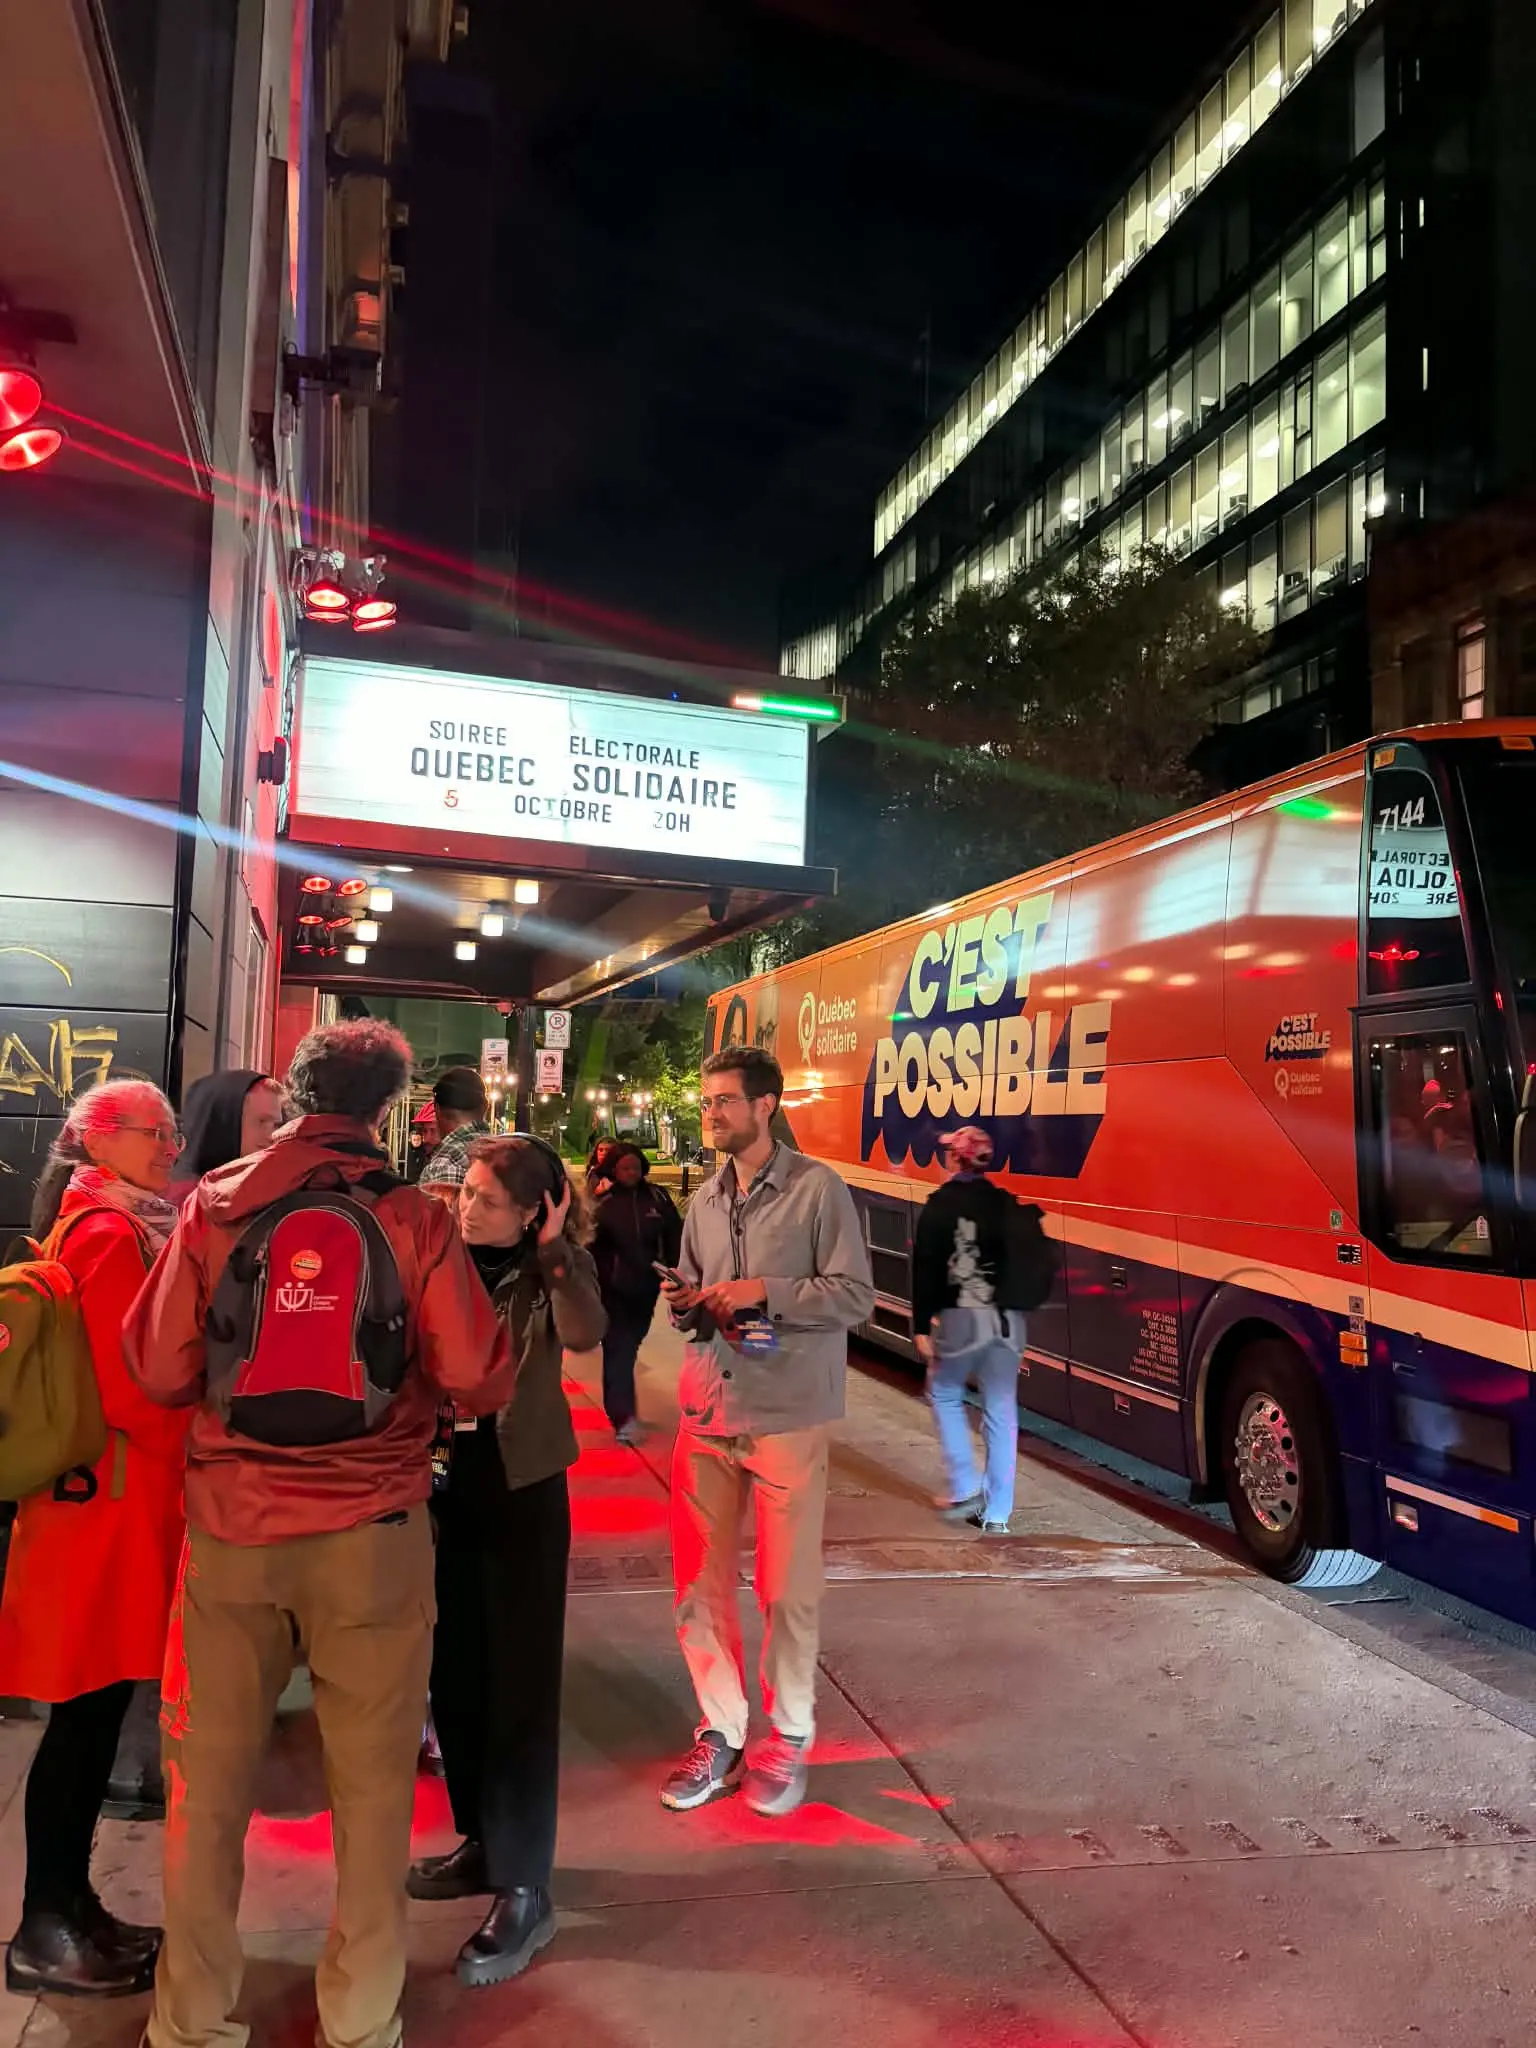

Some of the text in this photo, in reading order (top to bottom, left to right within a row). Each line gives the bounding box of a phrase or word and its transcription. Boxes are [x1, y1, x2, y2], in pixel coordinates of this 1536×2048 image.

[429, 720, 700, 770] SOIREE ELECTORALE
[411, 747, 737, 810] QUEBEC SOLIDAIRE
[443, 789, 691, 833] 5 OCTOBRE 20H
[1379, 797, 1425, 836] 7144
[909, 890, 1055, 1019] C'EST
[818, 994, 857, 1025] Québec
[1280, 1012, 1319, 1034] C'EST
[816, 1025, 857, 1057] solidaire
[873, 999, 1113, 1119] POSSIBLE
[1269, 1030, 1332, 1054] POSSIBLE
